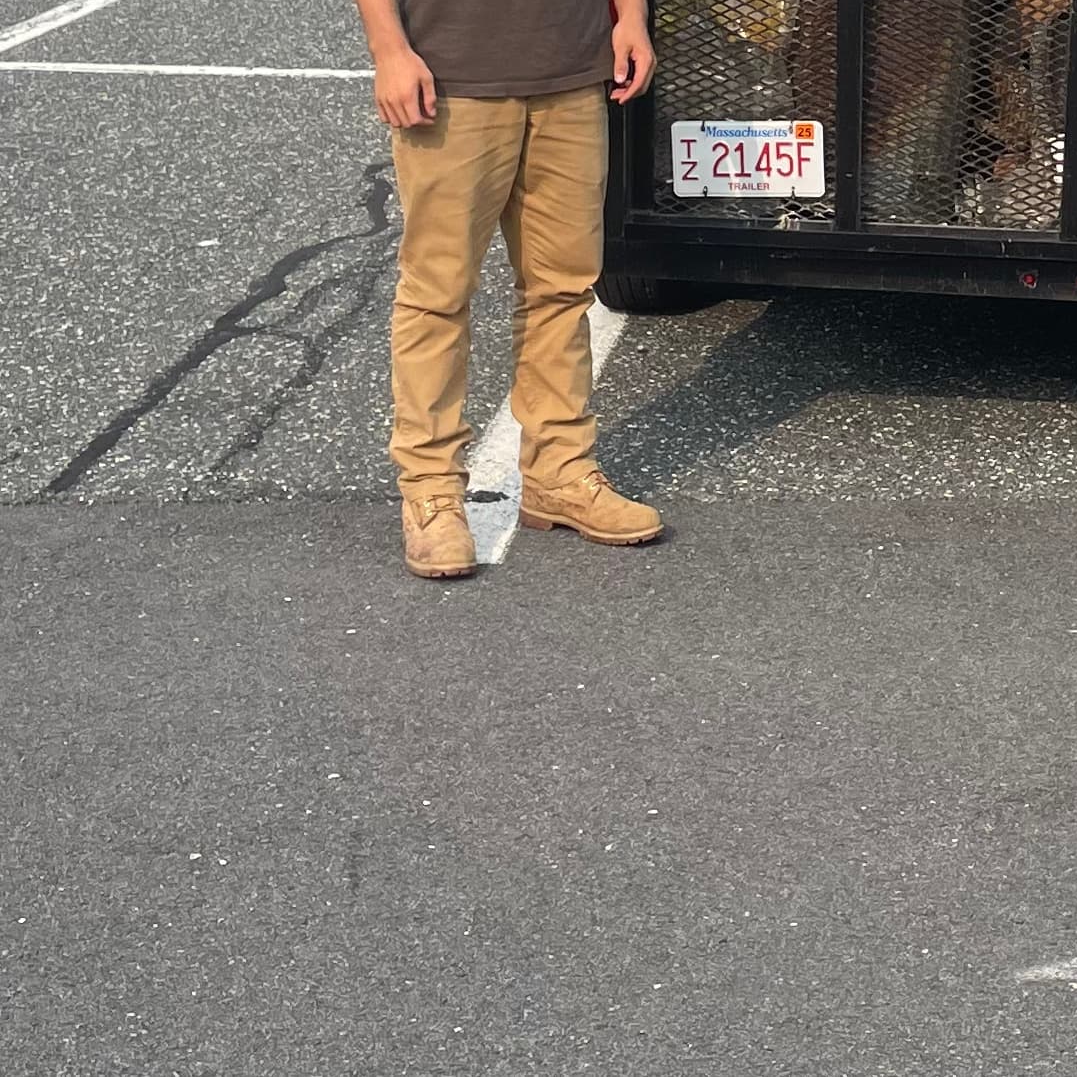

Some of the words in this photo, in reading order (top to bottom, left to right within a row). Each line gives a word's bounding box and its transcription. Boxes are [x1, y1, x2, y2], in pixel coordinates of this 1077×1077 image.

[705, 125, 788, 138] Massachusetts
[797, 127, 812, 137] 25
[711, 142, 815, 178] 2145F
[727, 182, 770, 191] TRAILER
